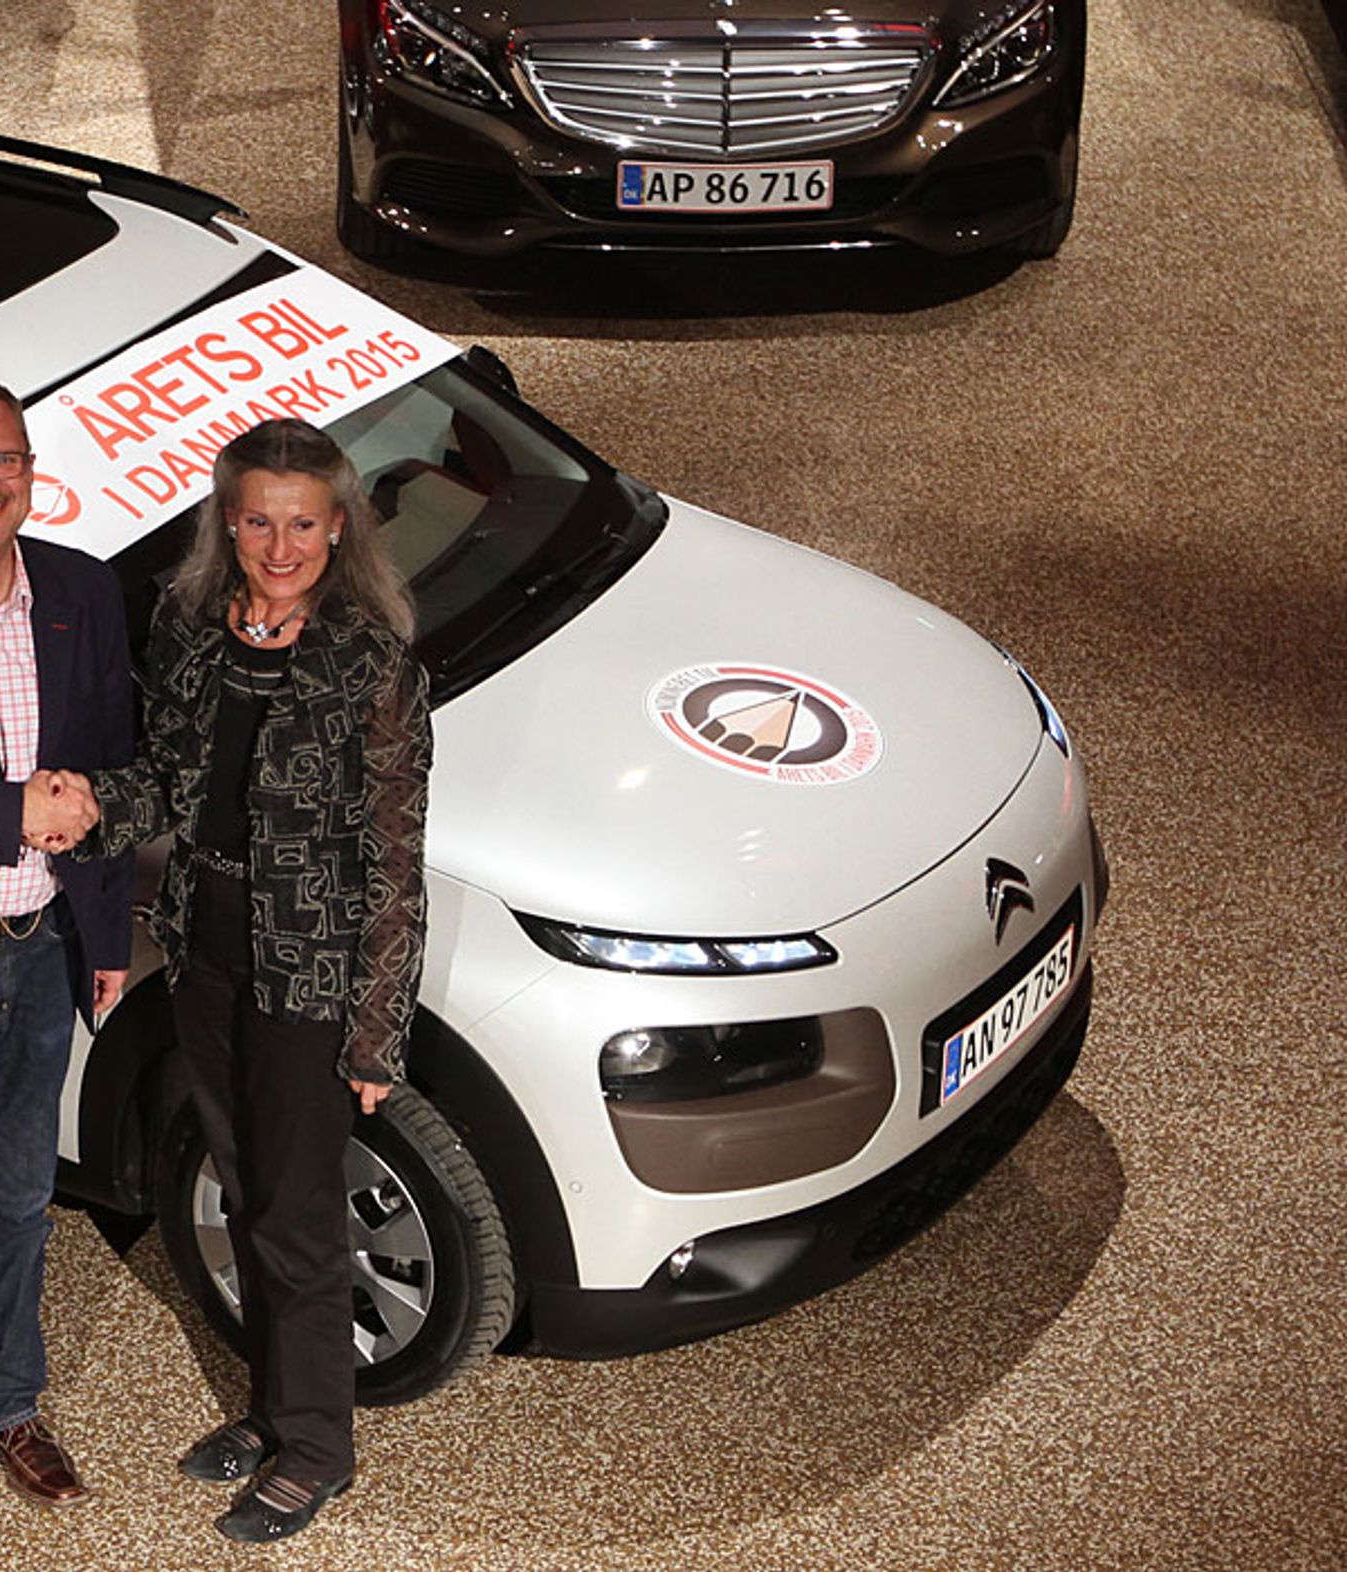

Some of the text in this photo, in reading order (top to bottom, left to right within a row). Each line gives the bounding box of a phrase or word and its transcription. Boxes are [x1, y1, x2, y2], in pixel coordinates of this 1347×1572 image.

[646, 169, 826, 204] AP 86 716
[58, 298, 349, 461] ÅRETS BIL
[101, 486, 144, 520] I
[327, 330, 421, 391] 2015
[963, 940, 1070, 1077] AN 97 785
